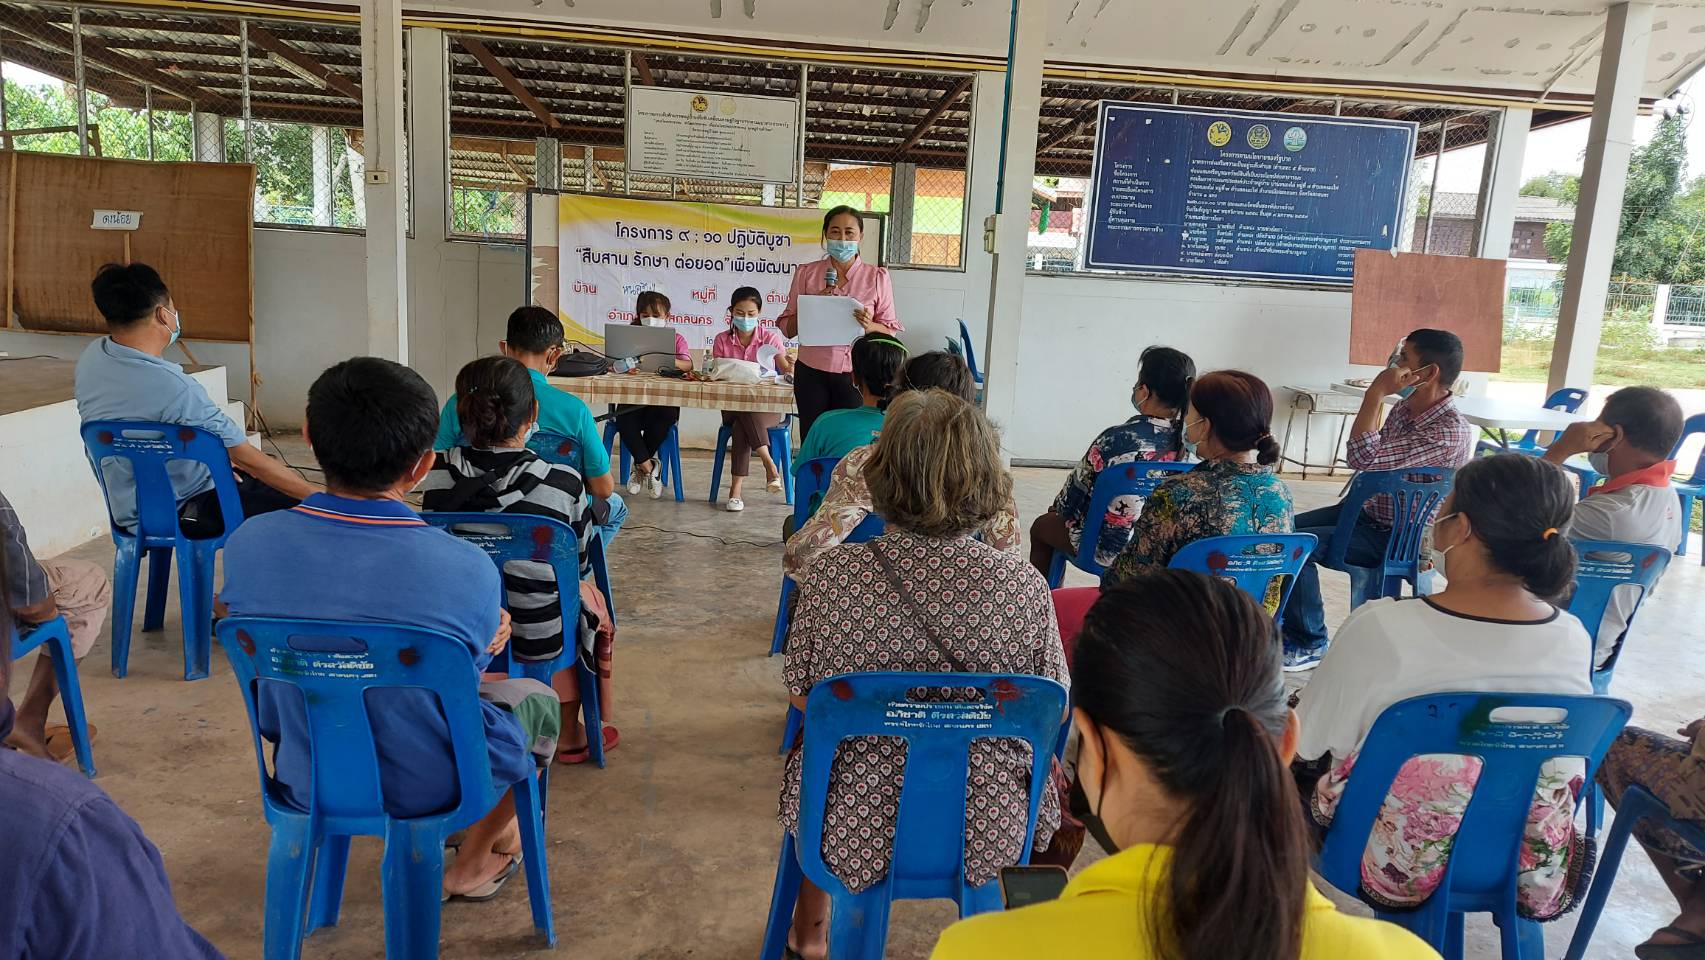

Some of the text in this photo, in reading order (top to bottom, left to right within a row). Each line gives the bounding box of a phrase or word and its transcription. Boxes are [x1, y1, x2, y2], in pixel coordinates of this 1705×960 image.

[616, 222, 673, 241] โครงการ
[728, 228, 791, 252] ปฏิบัติบูชา
[634, 251, 669, 268] รักษา
[573, 280, 598, 294] บ้าน
[692, 286, 717, 304] หมู่ที่
[766, 290, 790, 304] ตำบ
